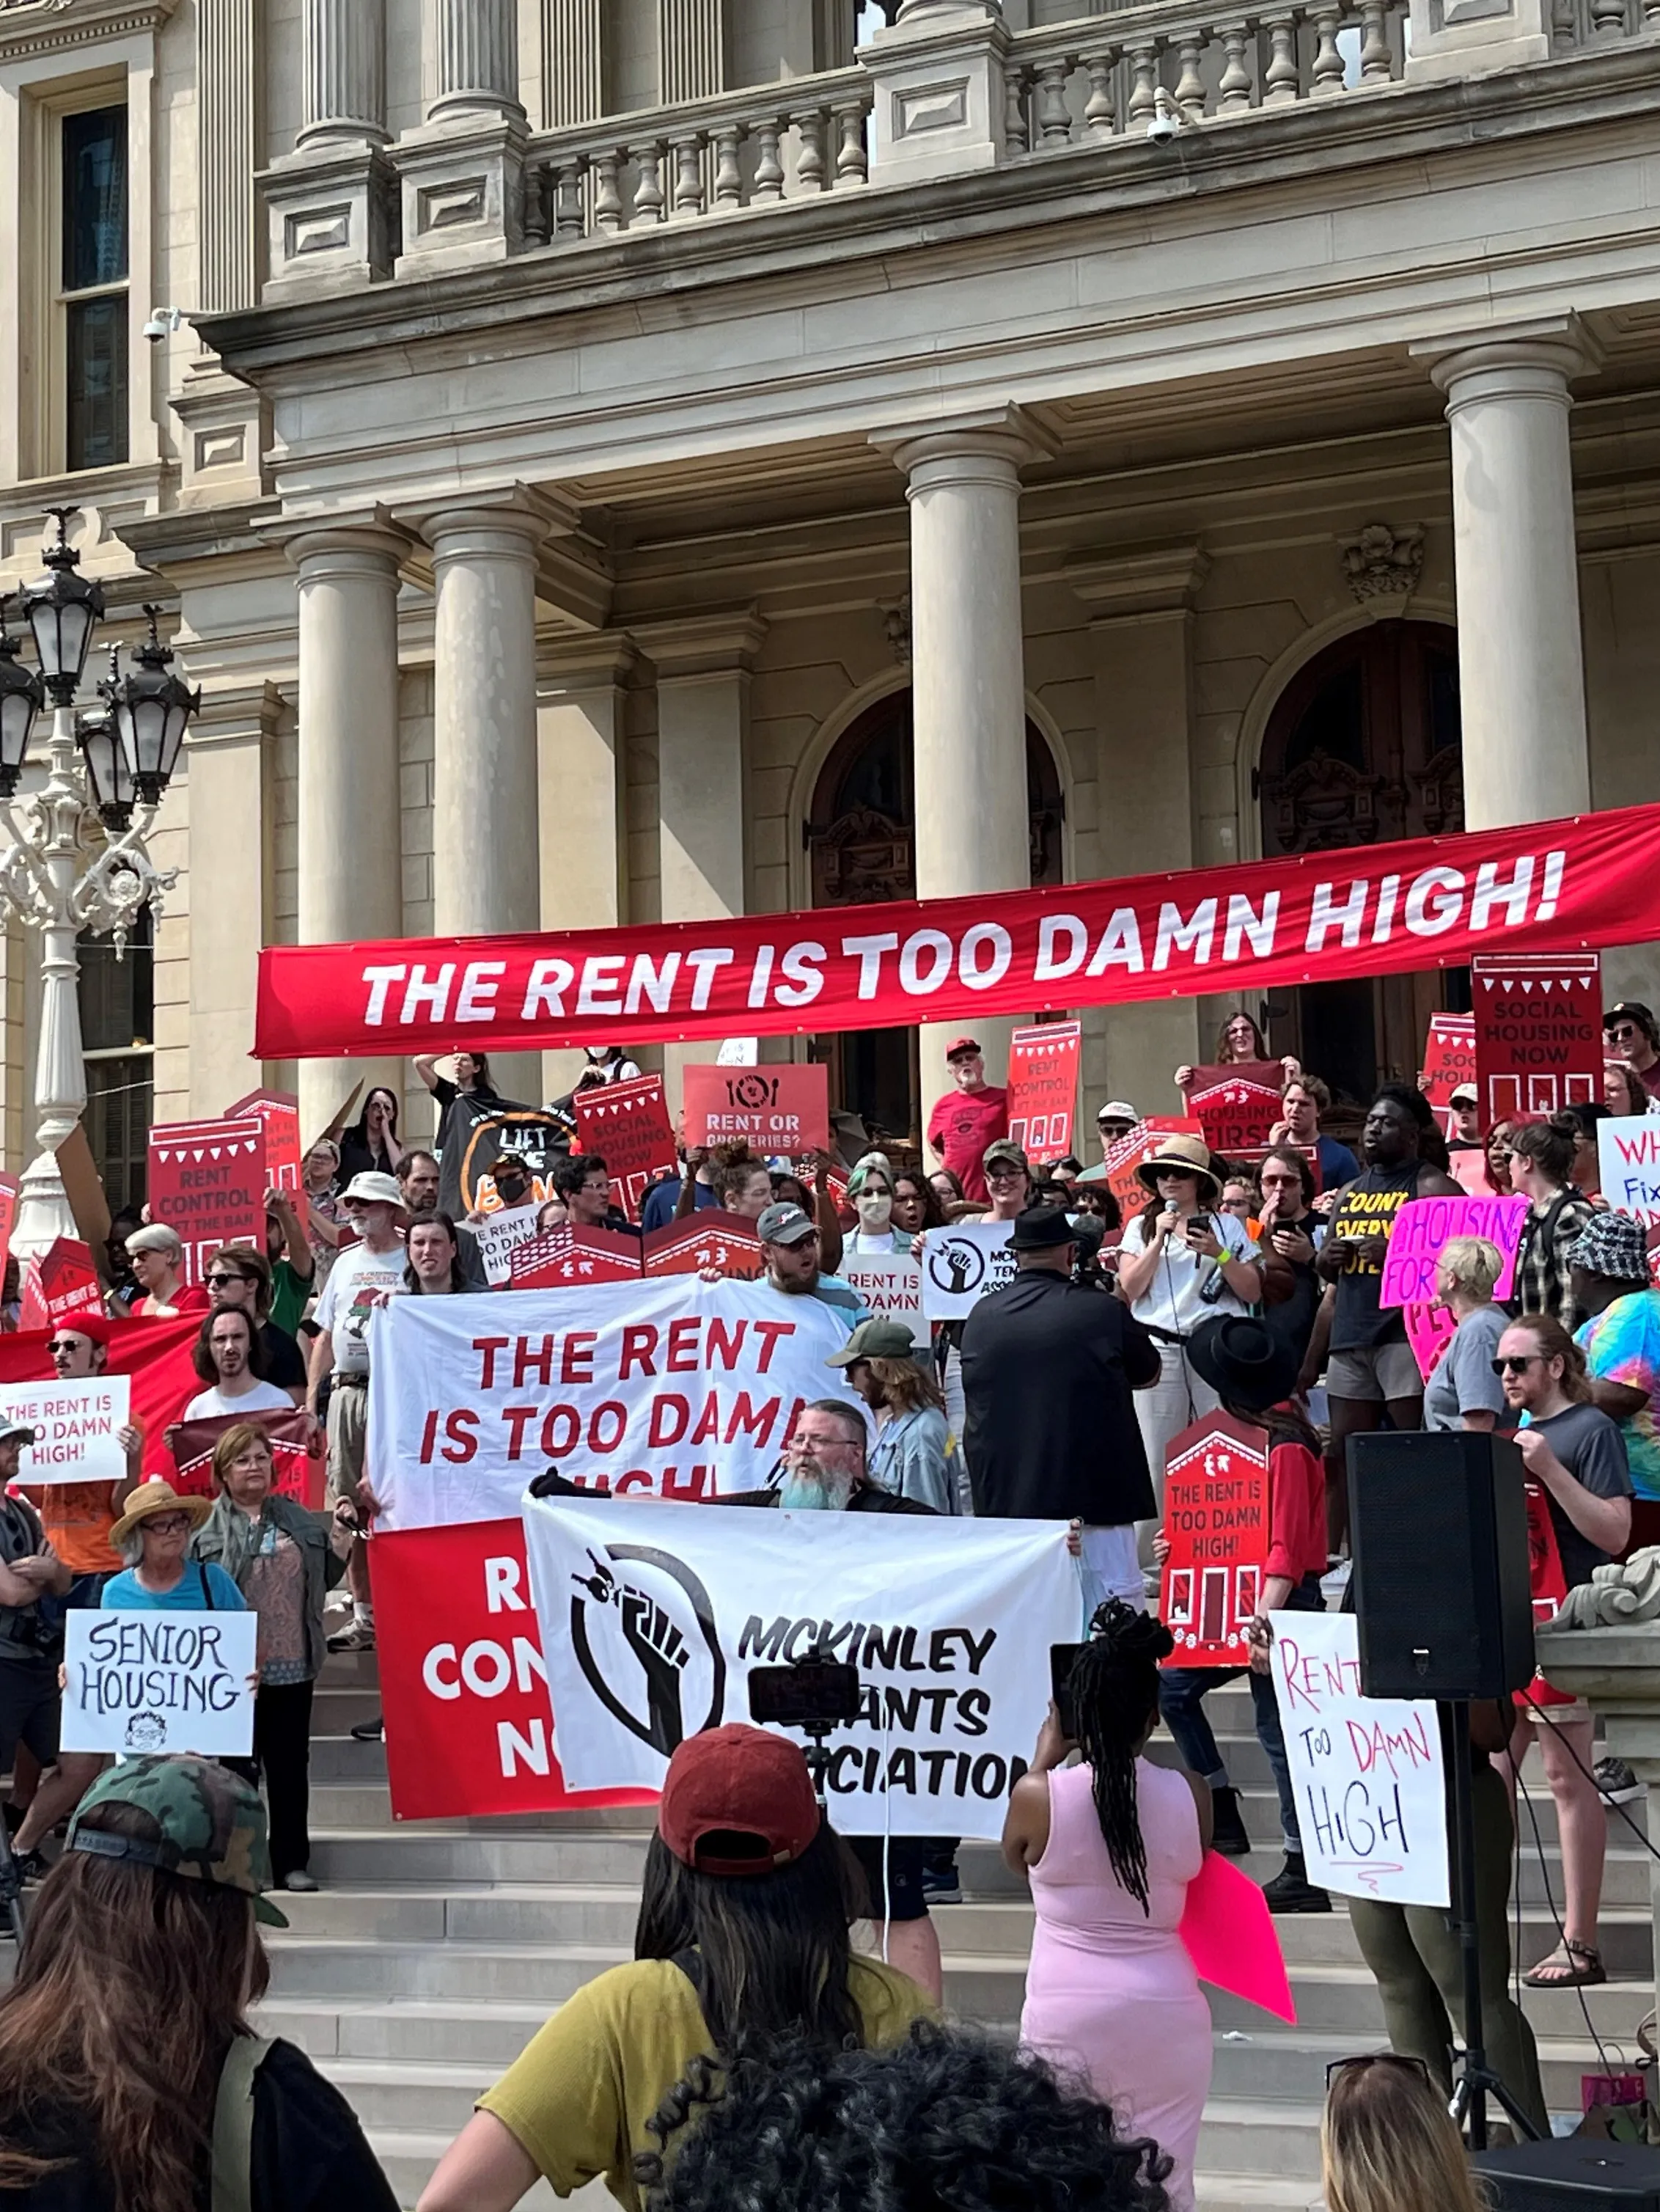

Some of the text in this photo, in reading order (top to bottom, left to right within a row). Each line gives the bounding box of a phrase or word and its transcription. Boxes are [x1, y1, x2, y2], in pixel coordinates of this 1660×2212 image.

[362, 851, 1566, 1025] THE RENT IS TOO DAMN HIGH!
[1494, 1001, 1583, 1019] SOCIAL
[1485, 1024, 1593, 1041] HOUSING
[1028, 1059, 1059, 1076] RENT
[1510, 1047, 1570, 1064] NOW
[1012, 1077, 1069, 1097] CONTROL
[592, 1113, 656, 1138] SOCIAL
[707, 1113, 800, 1131] RENT OR
[1197, 1105, 1279, 1122] HOUSING
[499, 1127, 547, 1150] LIFT
[590, 1127, 667, 1155] HOUSING
[609, 1148, 652, 1171] NOW
[180, 1165, 231, 1189] RENT
[159, 1189, 255, 1215] CONTROL
[474, 1171, 559, 1215] BN
[195, 1217, 222, 1232] THE
[224, 1213, 254, 1228] BAN
[490, 1218, 525, 1238] RENT
[1407, 1201, 1528, 1254] HOUSING
[848, 1272, 919, 1289] RENT IS
[1384, 1257, 1435, 1303] FOR
[473, 1316, 796, 1390] THE RENT
[6, 1394, 112, 1423] THE RENT IS
[54, 1416, 112, 1440] DAMN
[419, 1408, 481, 1465] IS
[502, 1400, 628, 1461] TOO
[32, 1442, 86, 1465] HIGH!
[1171, 1479, 1261, 1504] THE RENT IS
[1171, 1506, 1261, 1533] TOO DAMN
[1192, 1534, 1239, 1559] HIGH!
[89, 1616, 228, 1671] SENIOR
[738, 1614, 997, 1676] MCKINLEY
[1279, 1638, 1363, 1713] RENT
[79, 1662, 241, 1715] HOUSING
[838, 1683, 991, 1736] ANTS
[1345, 1711, 1431, 1780] DAMN
[1307, 1779, 1409, 1857] HIGH
